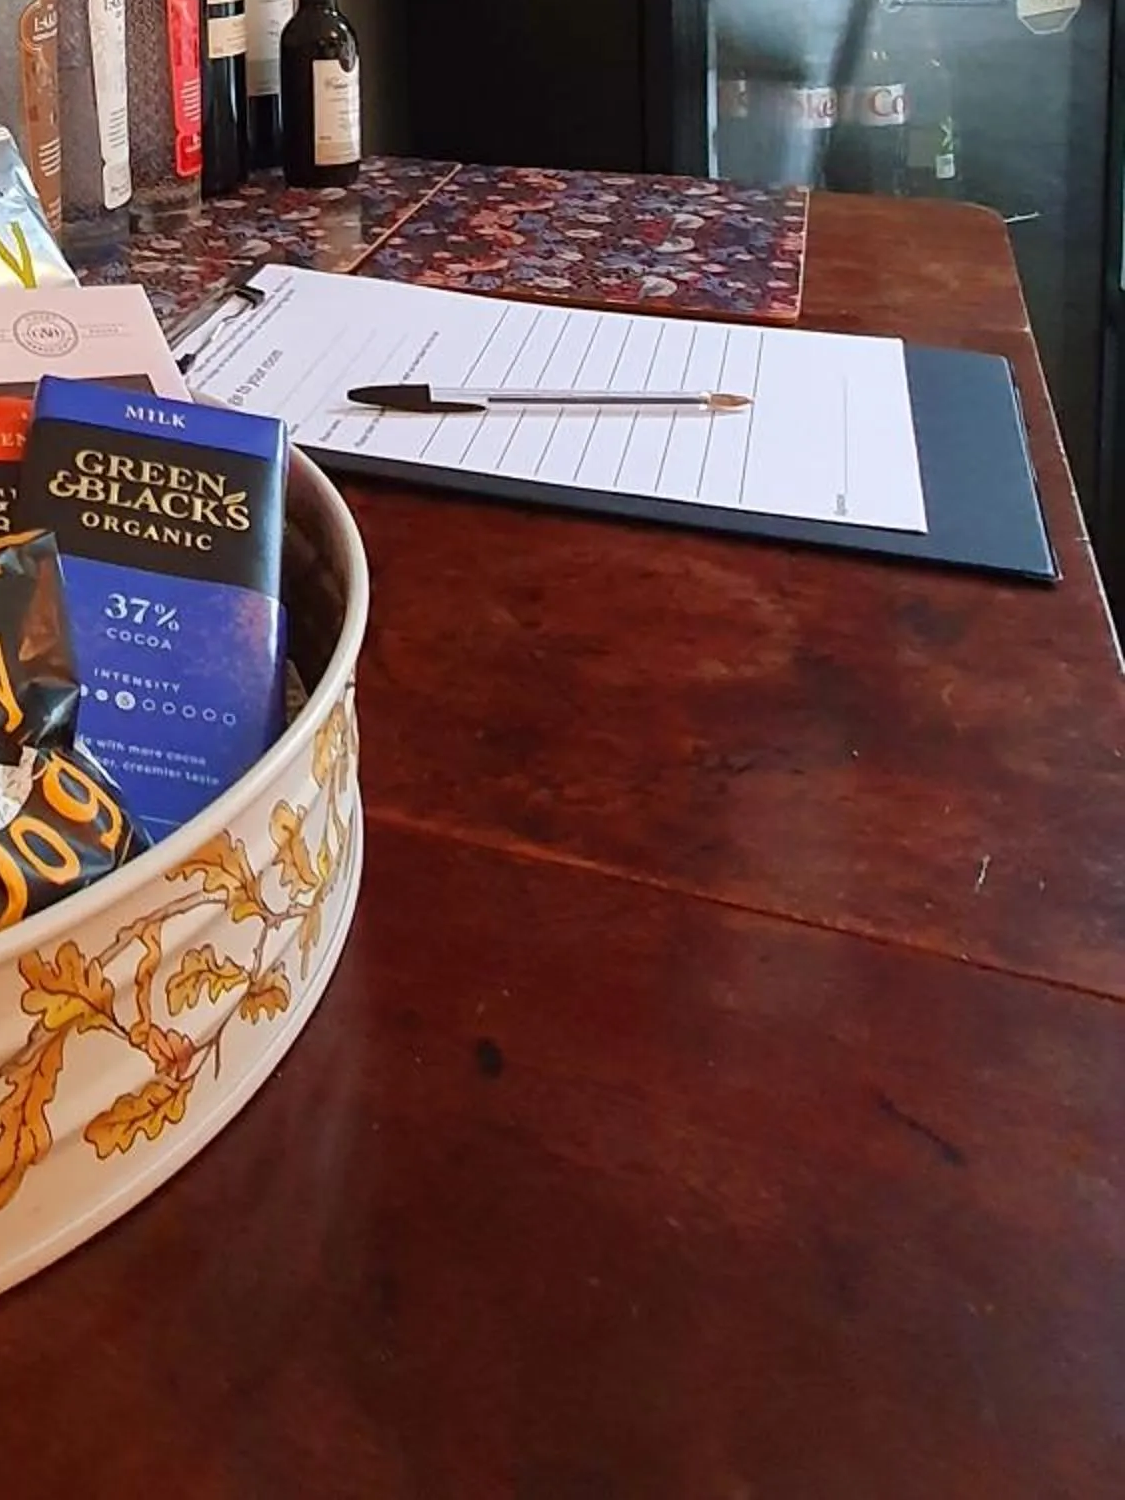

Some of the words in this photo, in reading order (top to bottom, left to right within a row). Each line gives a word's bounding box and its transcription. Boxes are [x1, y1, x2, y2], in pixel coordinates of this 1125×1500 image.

[124, 403, 187, 430] MILK
[74, 449, 227, 499] GREEN
[81, 510, 213, 552] ORGANIC
[104, 592, 180, 633] 37%
[106, 626, 173, 651] COCOA
[93, 666, 181, 695] INTENSITY
